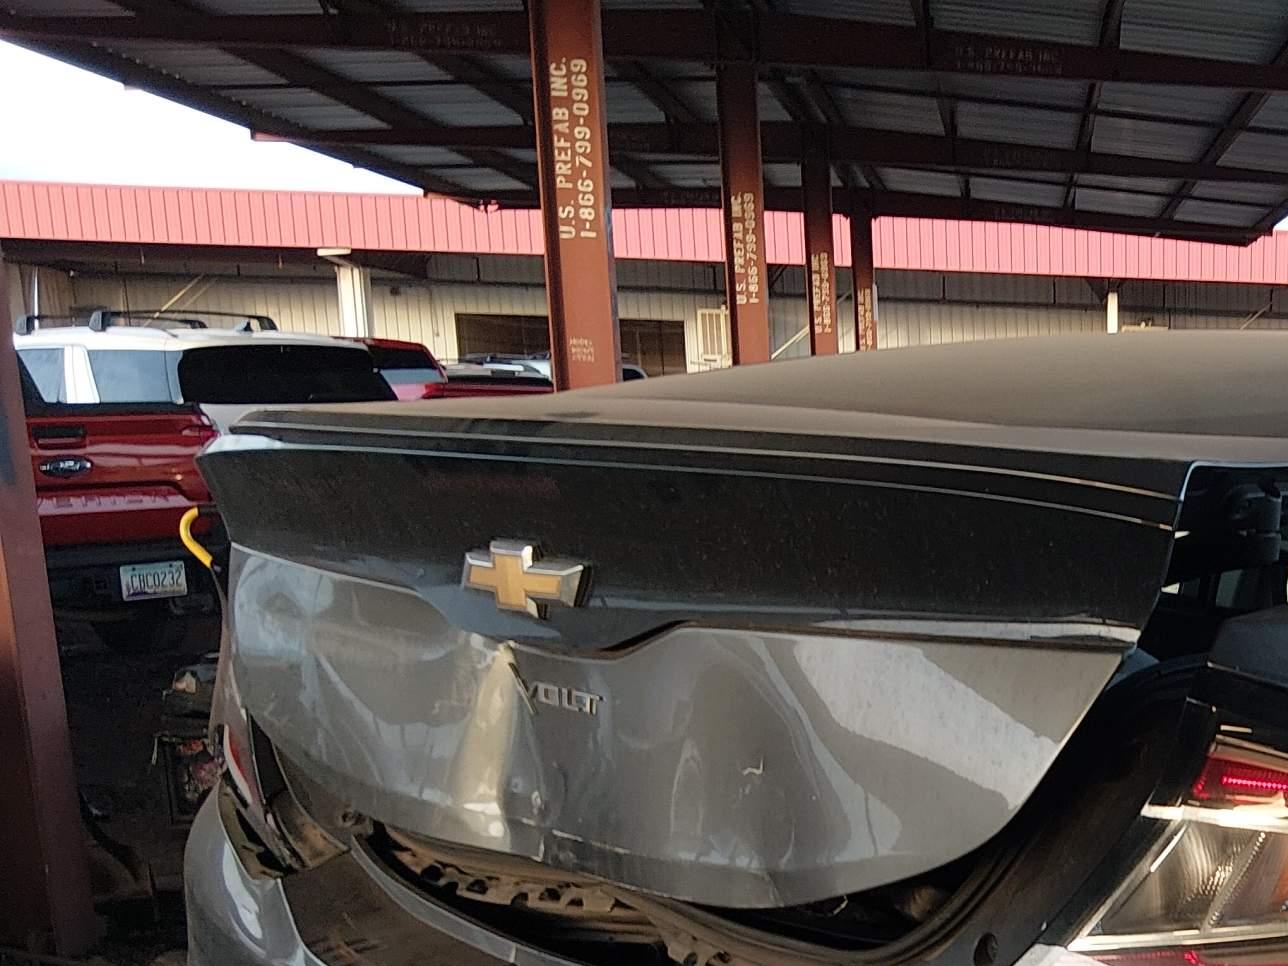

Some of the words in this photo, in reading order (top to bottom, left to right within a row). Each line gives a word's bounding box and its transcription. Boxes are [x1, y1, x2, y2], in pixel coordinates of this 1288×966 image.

[549, 57, 569, 97] INC.
[551, 107, 574, 189] PREFAB
[570, 59, 597, 239] 1-866-799-0969
[558, 200, 577, 240] U.S.
[732, 222, 745, 274] PREFAB
[508, 662, 604, 716] VOLT
